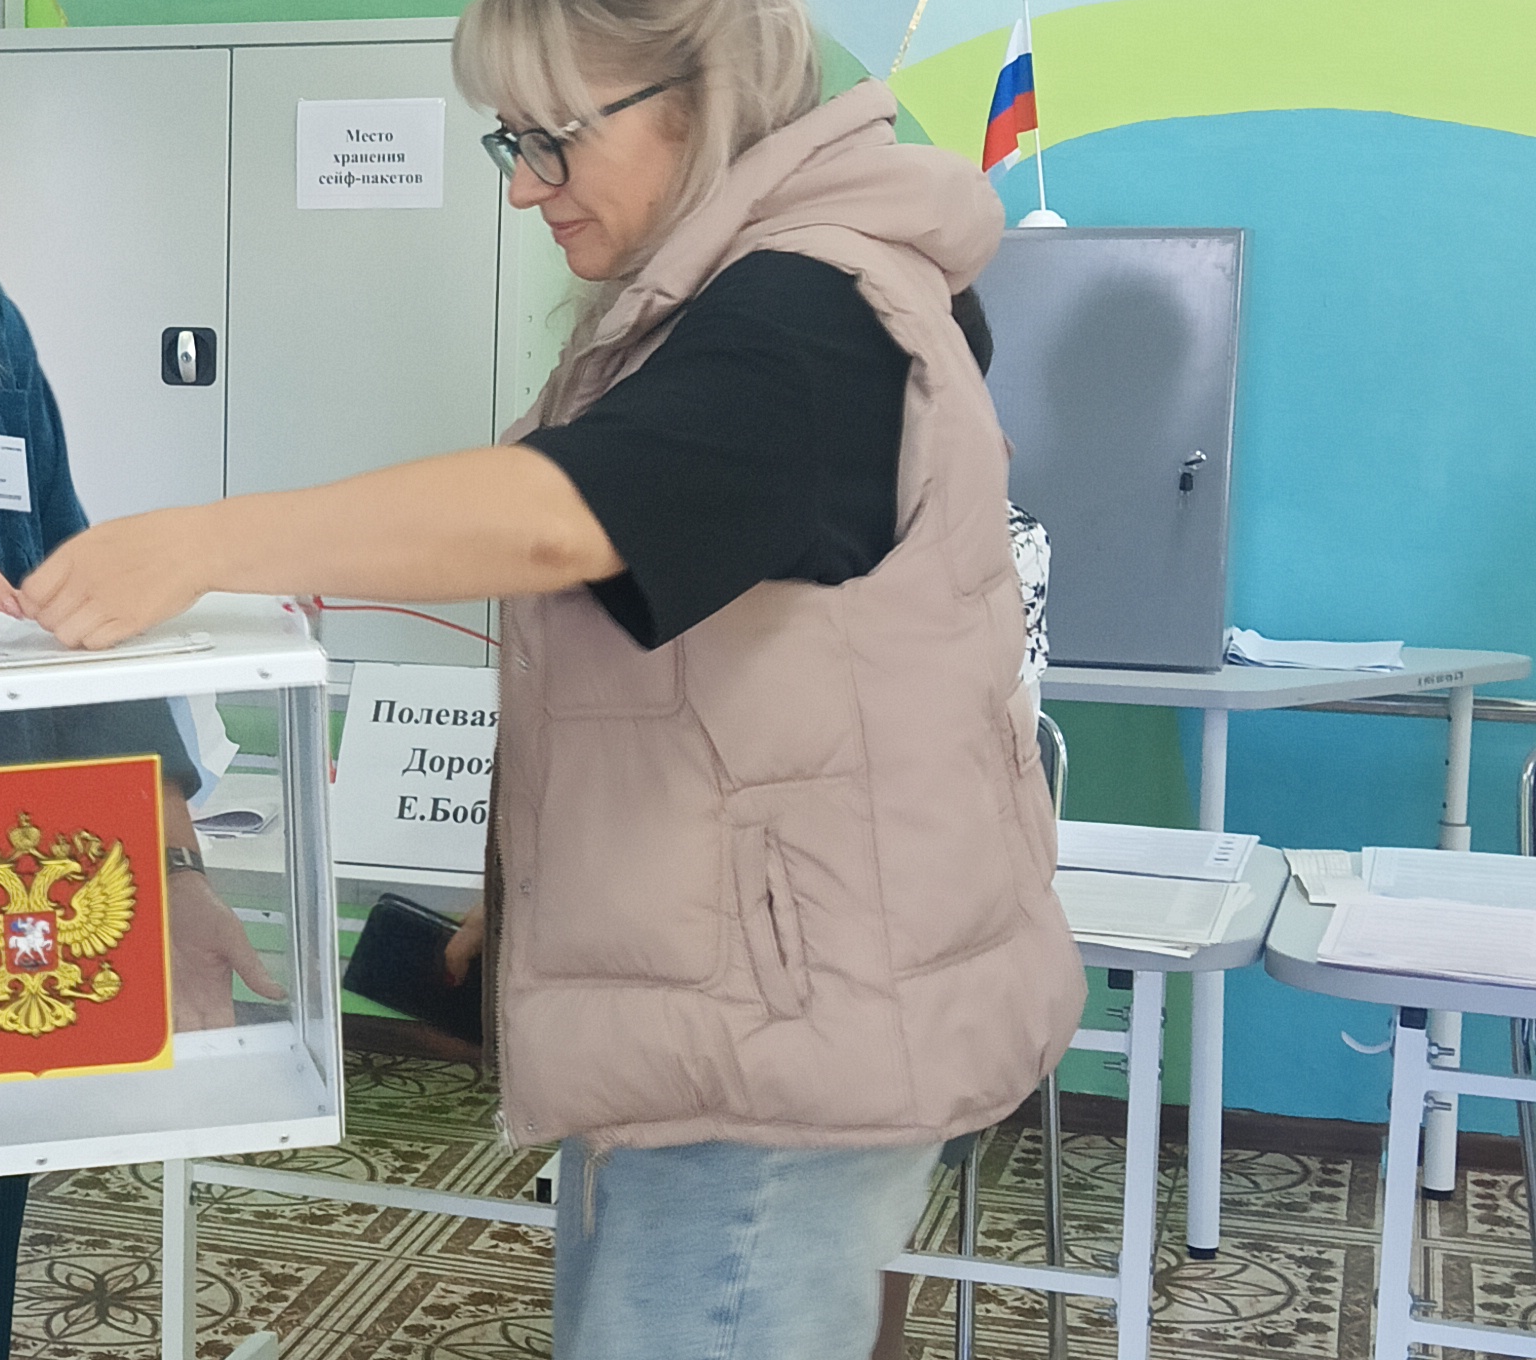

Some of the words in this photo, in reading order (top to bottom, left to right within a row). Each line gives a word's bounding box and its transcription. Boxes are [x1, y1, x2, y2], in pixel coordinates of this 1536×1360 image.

[345, 129, 394, 143] Место
[333, 152, 406, 167] хранения
[318, 171, 424, 188] сейф-пакетов
[371, 699, 500, 728] Полевая
[396, 795, 487, 825] Е.Боб
